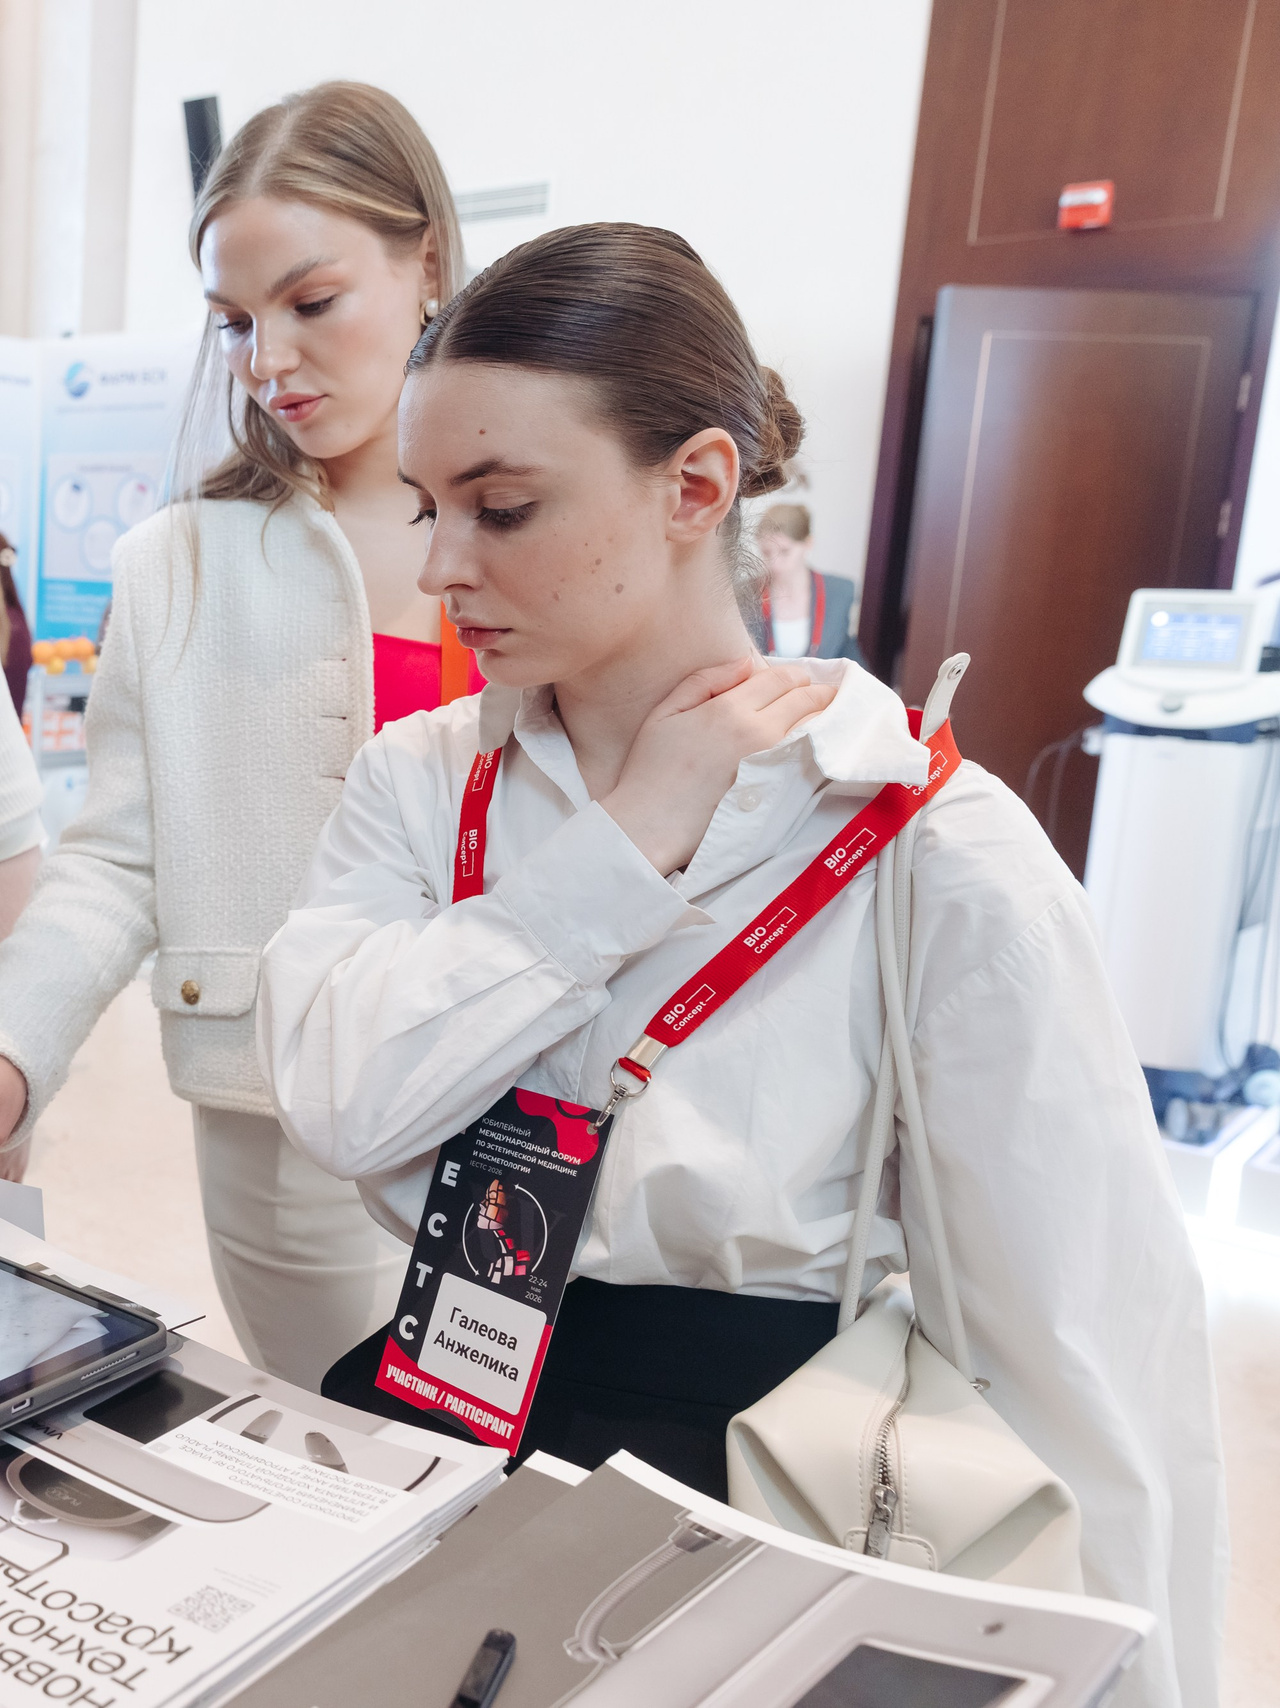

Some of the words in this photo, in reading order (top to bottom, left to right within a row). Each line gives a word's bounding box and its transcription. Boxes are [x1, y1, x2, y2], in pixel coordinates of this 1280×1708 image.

[468, 829, 478, 850] BIO
[824, 847, 847, 871] BIO
[834, 844, 867, 877] Concept
[743, 926, 767, 950] BIO
[753, 922, 788, 955] Concept
[662, 1002, 686, 1027] BIO
[672, 1000, 707, 1032] Concept
[482, 1117, 531, 1137] ЮБИЛЕЙНЫЙ
[476, 1139, 486, 1147] ПО
[487, 1143, 536, 1163] ЭСТЕТИЧЕСКОЙ
[537, 1159, 577, 1177] МЕДИЦИНЕ
[479, 1128, 550, 1156] МЕЖДУНАРОДНЫЙ
[551, 1150, 581, 1165] ФОРУМ
[479, 1152, 531, 1174] КОСМЕТОЛОГИИ
[487, 1166, 503, 1176] 2026
[528, 1275, 548, 1288] 22-24
[525, 1291, 542, 1303] 2026
[449, 1306, 518, 1351] Галеова
[433, 1329, 520, 1382] Анжелика
[385, 1363, 438, 1404] УЧАСТНИК
[437, 1390, 446, 1404] /
[443, 1393, 516, 1440] PARTICIPANT
[174, 1432, 213, 1452] PLADUO
[177, 1444, 212, 1462] VIVACE
[211, 1439, 291, 1474] АТРОФИЧЕСКИХ
[211, 1449, 256, 1470] ПЛАЗМЫ
[226, 1464, 296, 1494] ИГОЛЬЧАТОГО
[254, 1466, 313, 1490] ХОЛОДНОЙ
[297, 1463, 353, 1485] ПОСТАКНЕ
[298, 1472, 329, 1486] АКНЕ
[228, 1474, 301, 1504] СОЧЕТАННОГО
[313, 1486, 368, 1508] АППАРАТА
[327, 1482, 378, 1502] ТЕРАПИИ
[352, 1481, 397, 1500] РУБЦОВ
[295, 1490, 370, 1517] ПРИМЕНЕНИЯ
[301, 1501, 360, 1525] ПРОТОКОЛ
